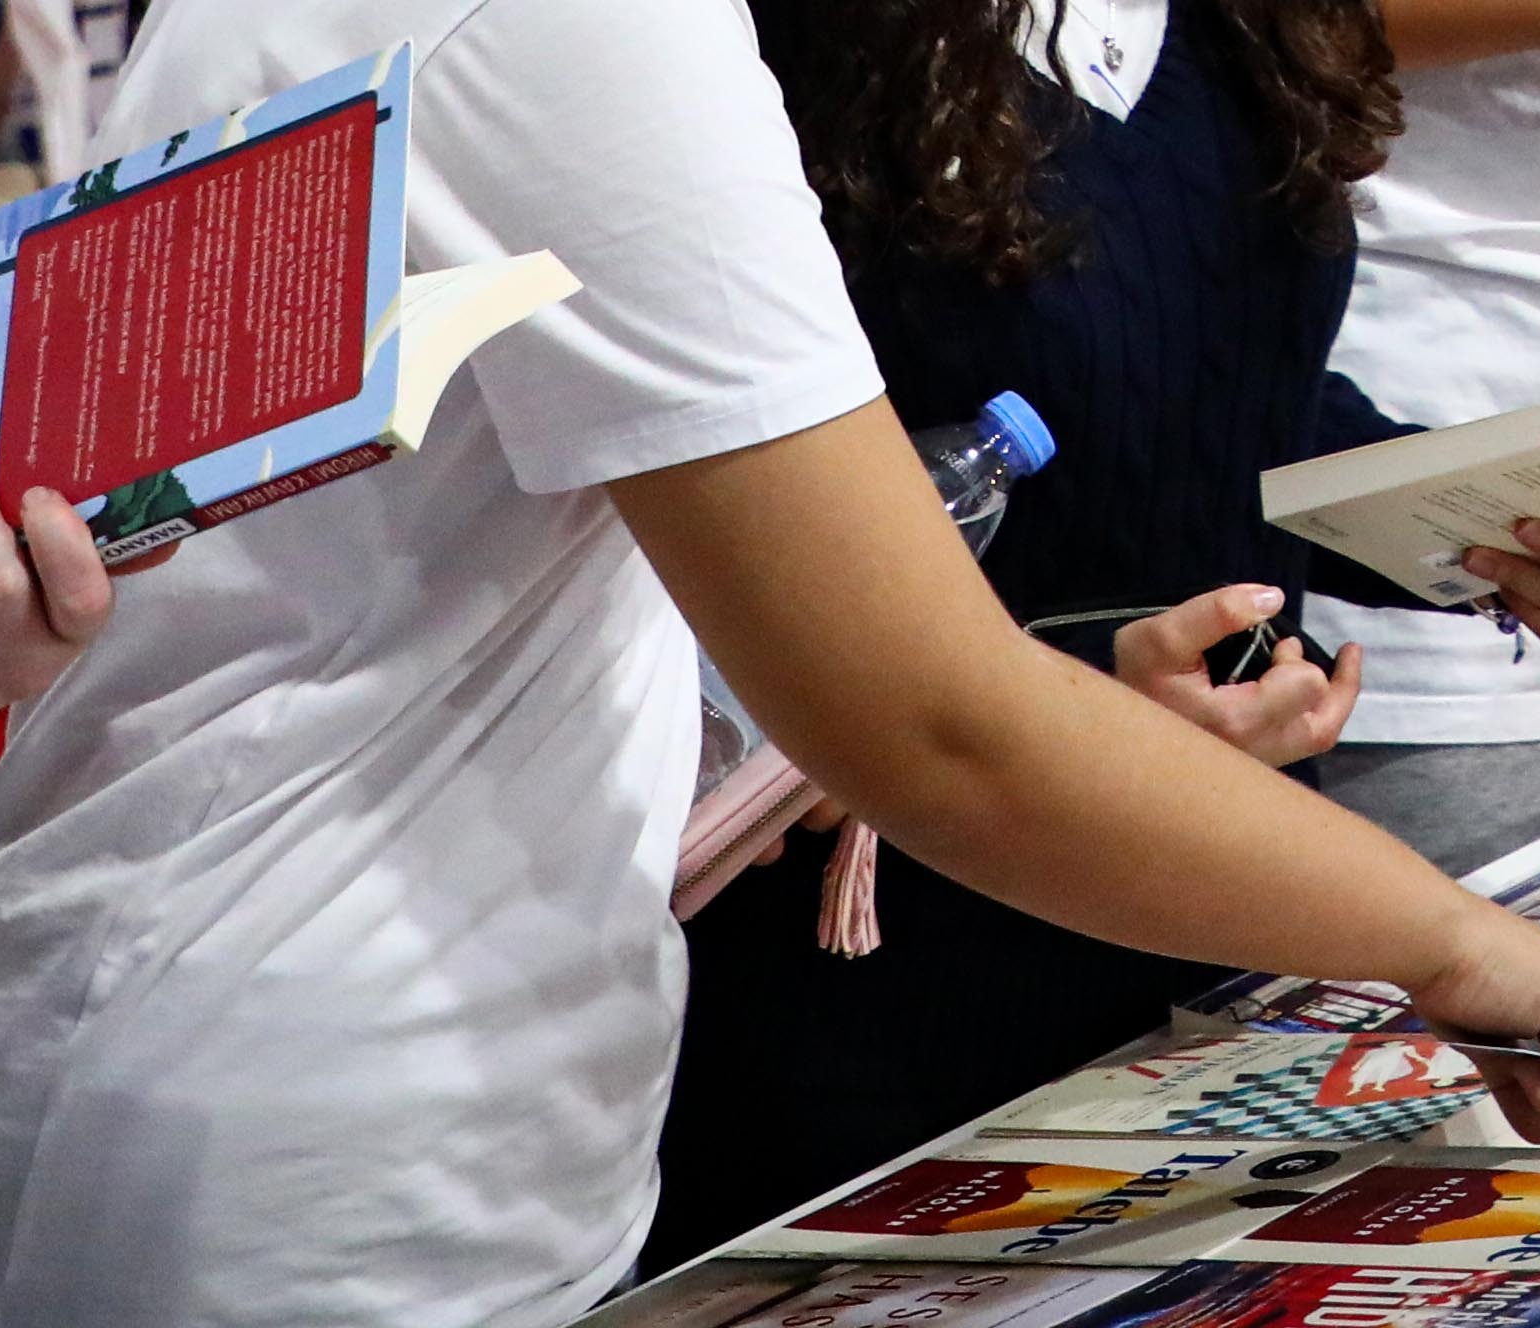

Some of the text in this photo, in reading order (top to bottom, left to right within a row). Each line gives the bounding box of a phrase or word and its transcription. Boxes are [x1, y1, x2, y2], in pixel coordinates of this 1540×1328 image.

[207, 447, 379, 520] HIROMI KAWAKAMI
[105, 522, 186, 558] NAKANO
[1001, 1148, 1250, 1255] Talebe
[888, 1275, 1008, 1328] SES
